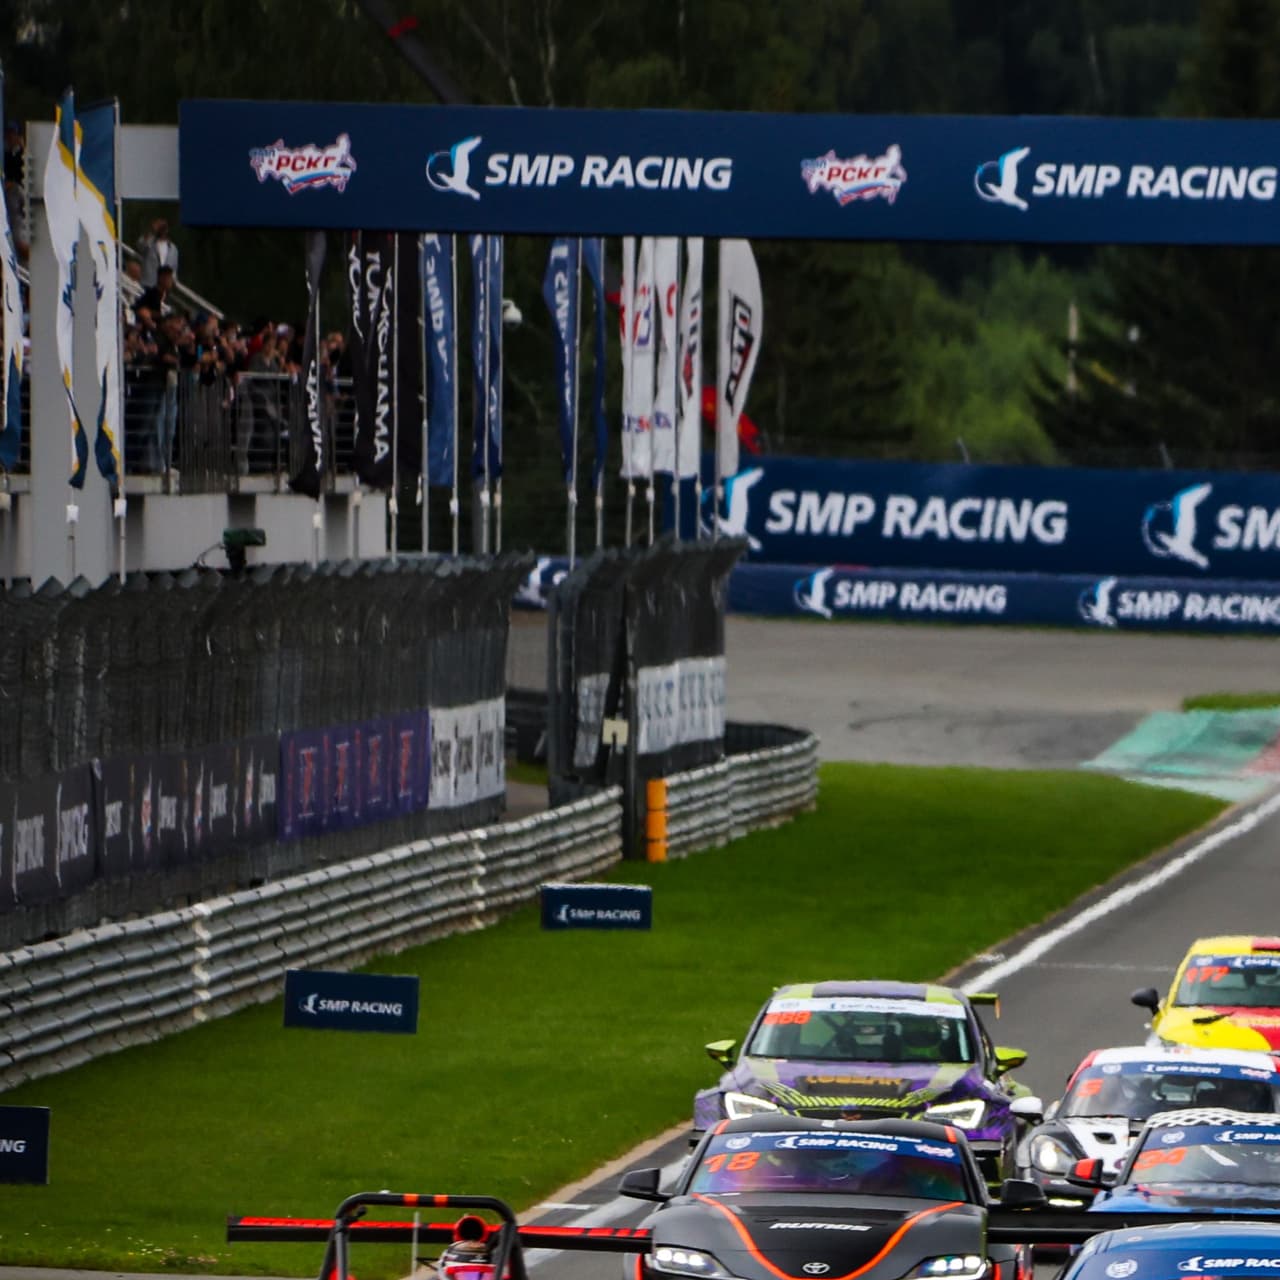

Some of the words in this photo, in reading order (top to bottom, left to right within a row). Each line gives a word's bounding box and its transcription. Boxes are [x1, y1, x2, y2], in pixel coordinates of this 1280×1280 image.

[484, 153, 576, 186] SMP
[579, 155, 733, 190] RACING
[1032, 163, 1122, 196] SMP
[1126, 165, 1278, 200] RACING
[765, 490, 876, 536] SMP
[882, 495, 1069, 545] RACING
[833, 579, 894, 607] SMP
[898, 582, 1007, 612] RACING
[1117, 591, 1178, 620] SMP
[569, 908, 595, 919] SMP
[596, 909, 641, 921] RACING
[318, 998, 349, 1013] SMP
[351, 1001, 403, 1016] RACING
[798, 1134, 837, 1147] SMP
[838, 1138, 899, 1152] RACING
[1234, 1132, 1263, 1141] SMP
[703, 1151, 761, 1173] 18
[1203, 1258, 1244, 1269] SMP
